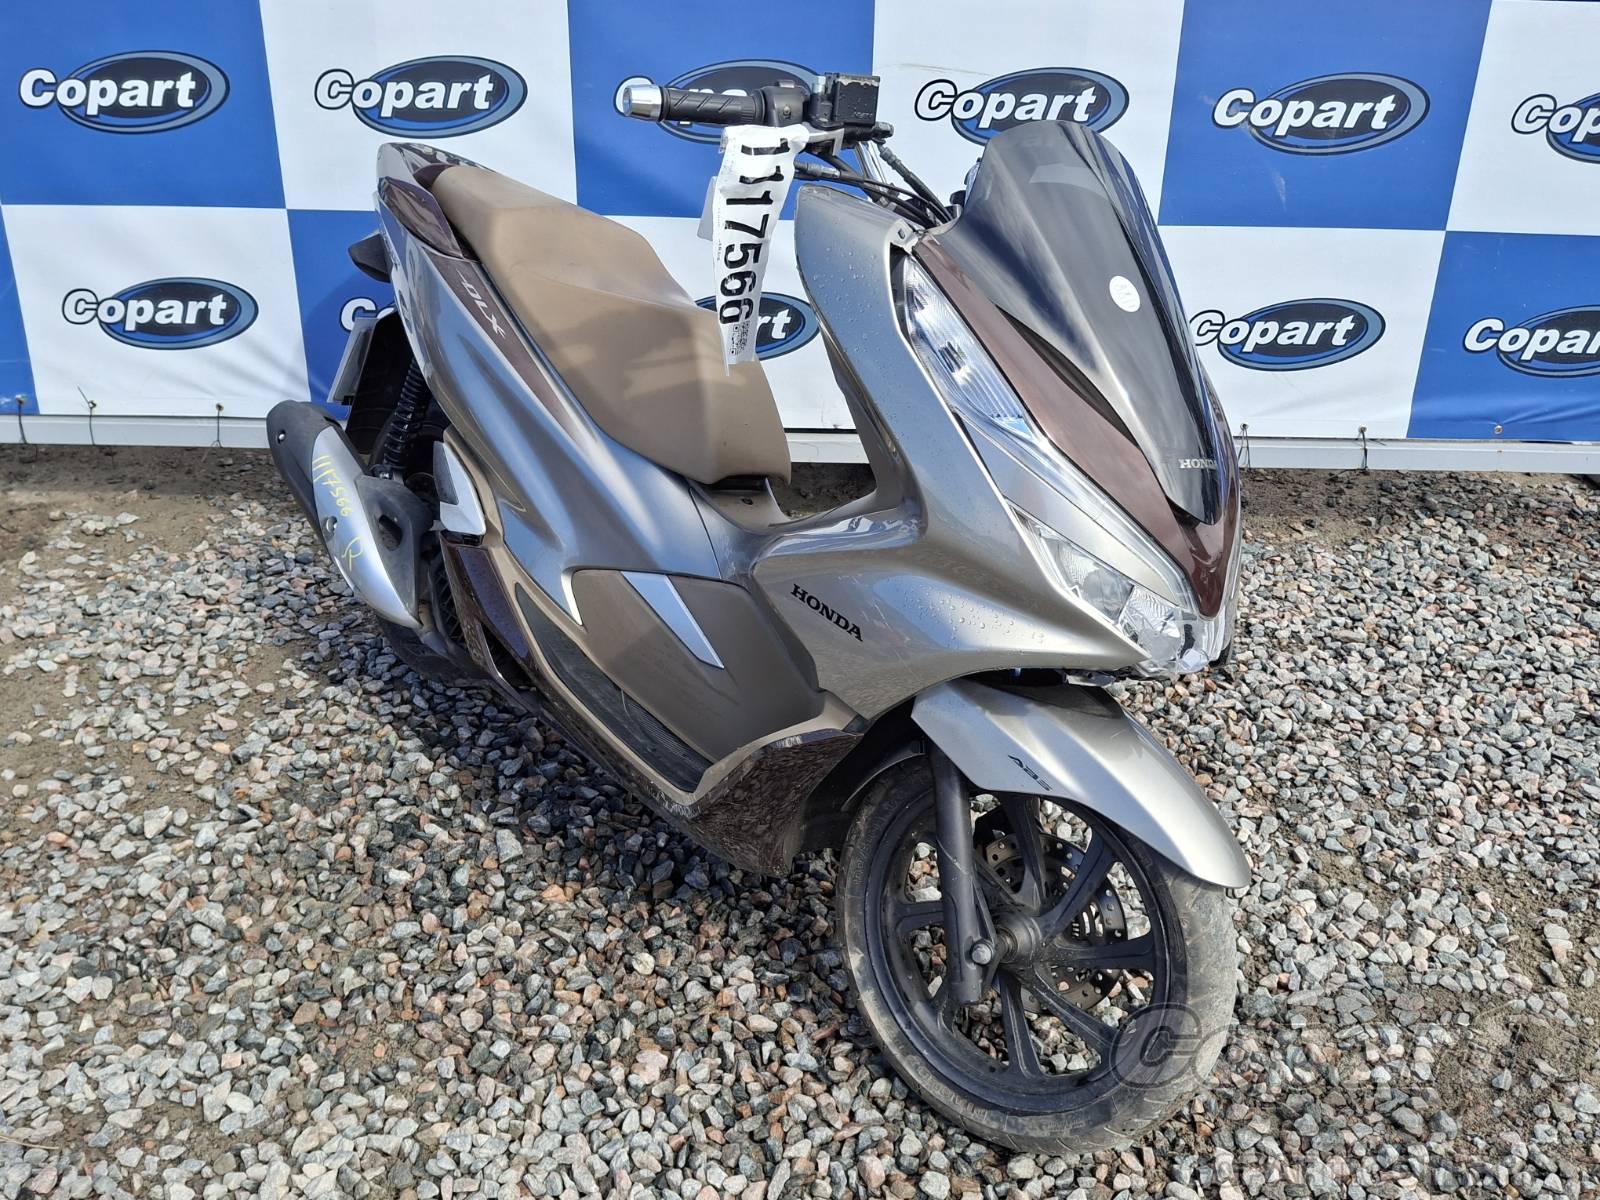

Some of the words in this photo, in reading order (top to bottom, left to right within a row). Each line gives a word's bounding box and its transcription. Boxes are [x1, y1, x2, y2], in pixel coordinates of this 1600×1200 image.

[19, 68, 196, 116] Copart
[315, 68, 494, 118] Copart
[914, 79, 1096, 129] Copart
[1212, 88, 1396, 137] Copart
[719, 137, 791, 325] 1117566
[62, 288, 228, 332] Copart
[1190, 309, 1355, 353] Copart
[1177, 458, 1217, 470] HOND
[790, 583, 864, 642] HONDA
[1007, 754, 1054, 792] ABS
